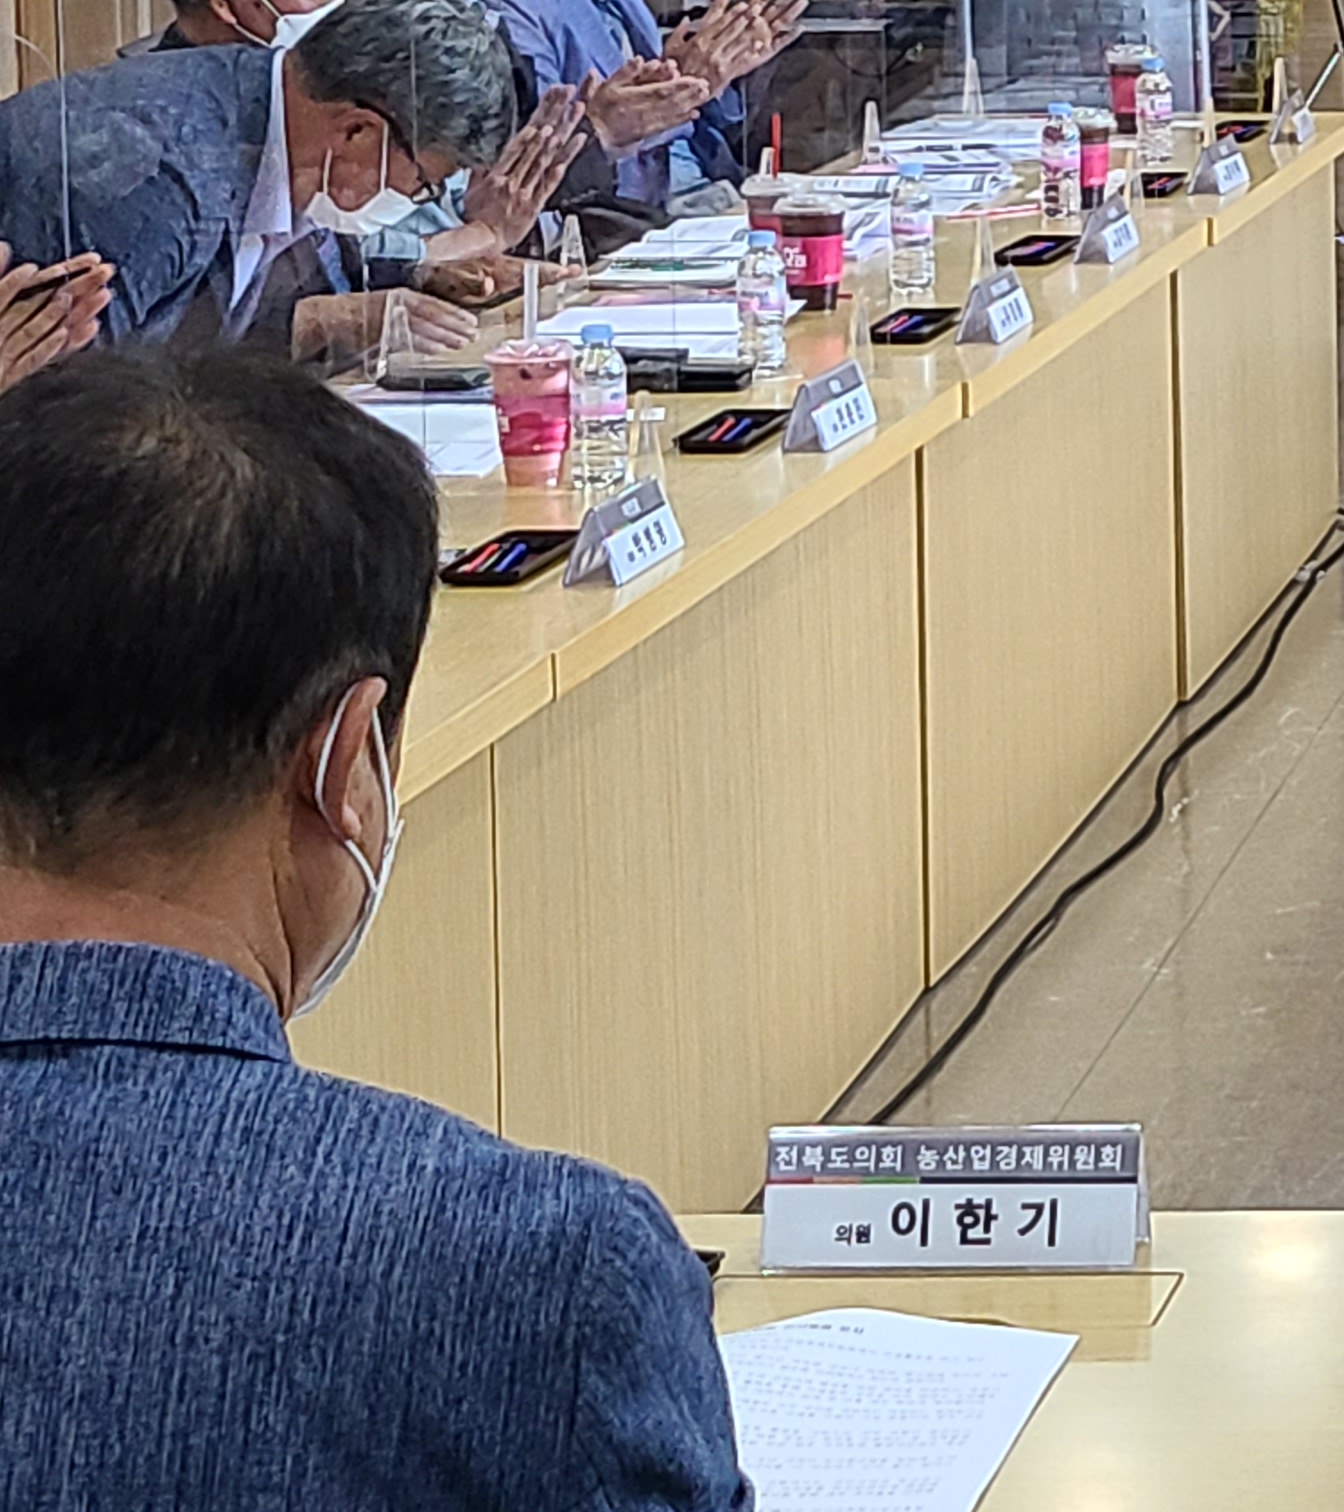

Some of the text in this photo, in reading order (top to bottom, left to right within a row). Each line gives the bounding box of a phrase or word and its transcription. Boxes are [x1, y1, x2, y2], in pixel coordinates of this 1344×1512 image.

[773, 1143, 1125, 1173] 전북도의회 농산업경제위원회
[833, 1222, 873, 1247] 의원
